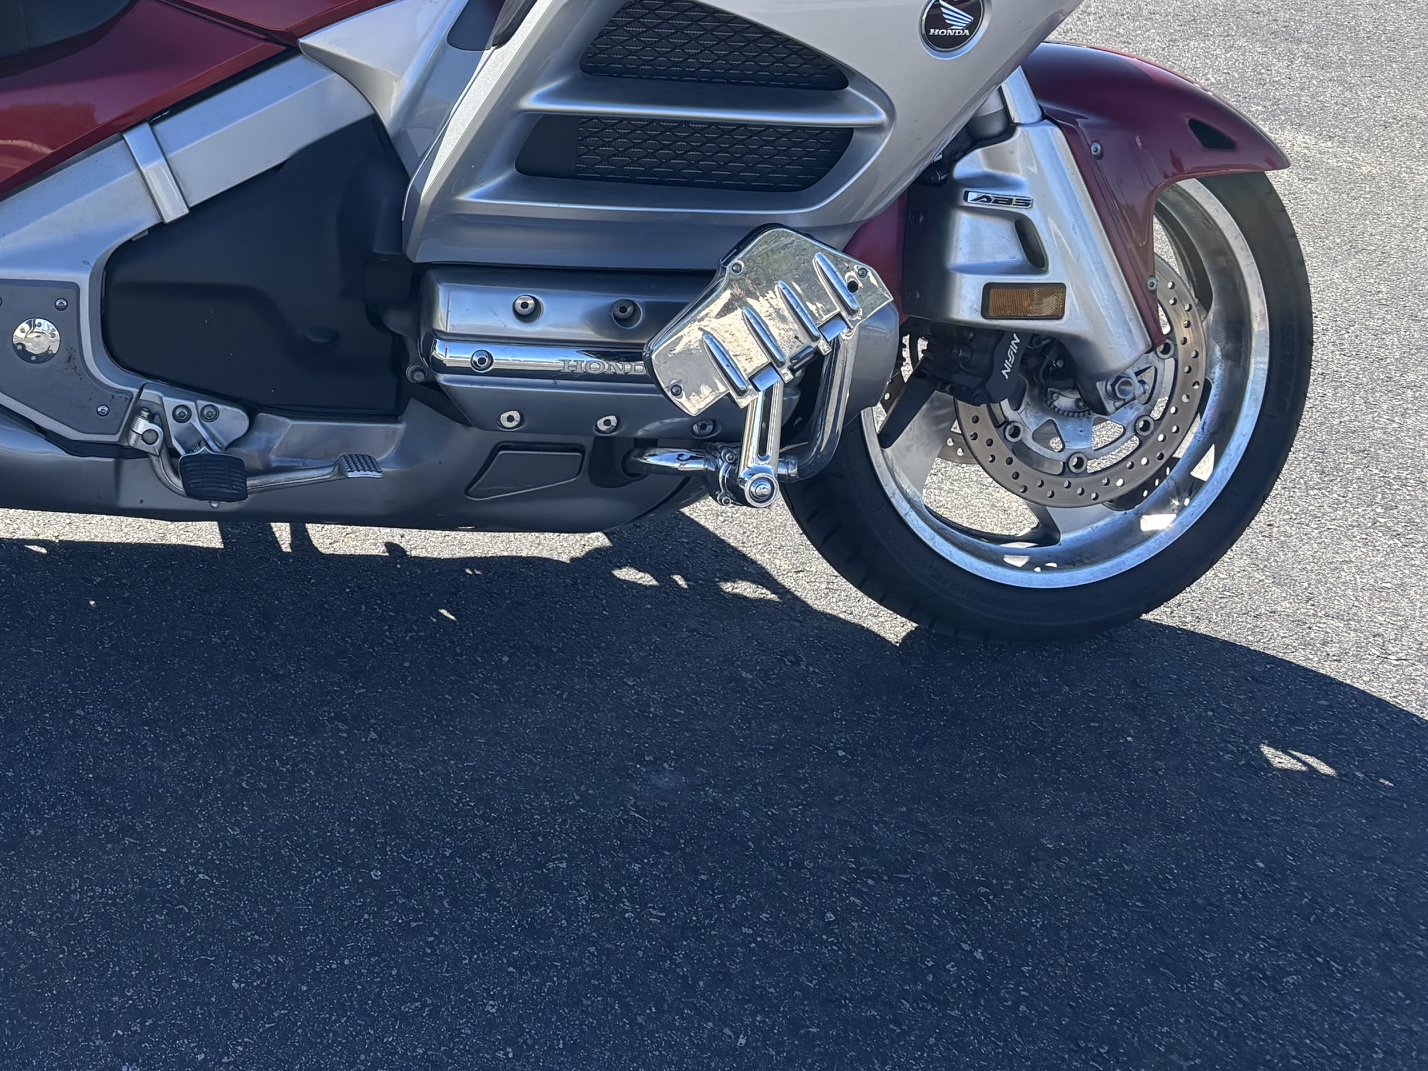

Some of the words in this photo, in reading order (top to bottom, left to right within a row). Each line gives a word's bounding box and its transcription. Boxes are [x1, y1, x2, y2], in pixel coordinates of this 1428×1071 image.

[929, 28, 970, 36] HONDA
[969, 193, 1032, 208] ABS
[1001, 332, 1021, 380] NISSIN
[559, 359, 648, 375] HOND
